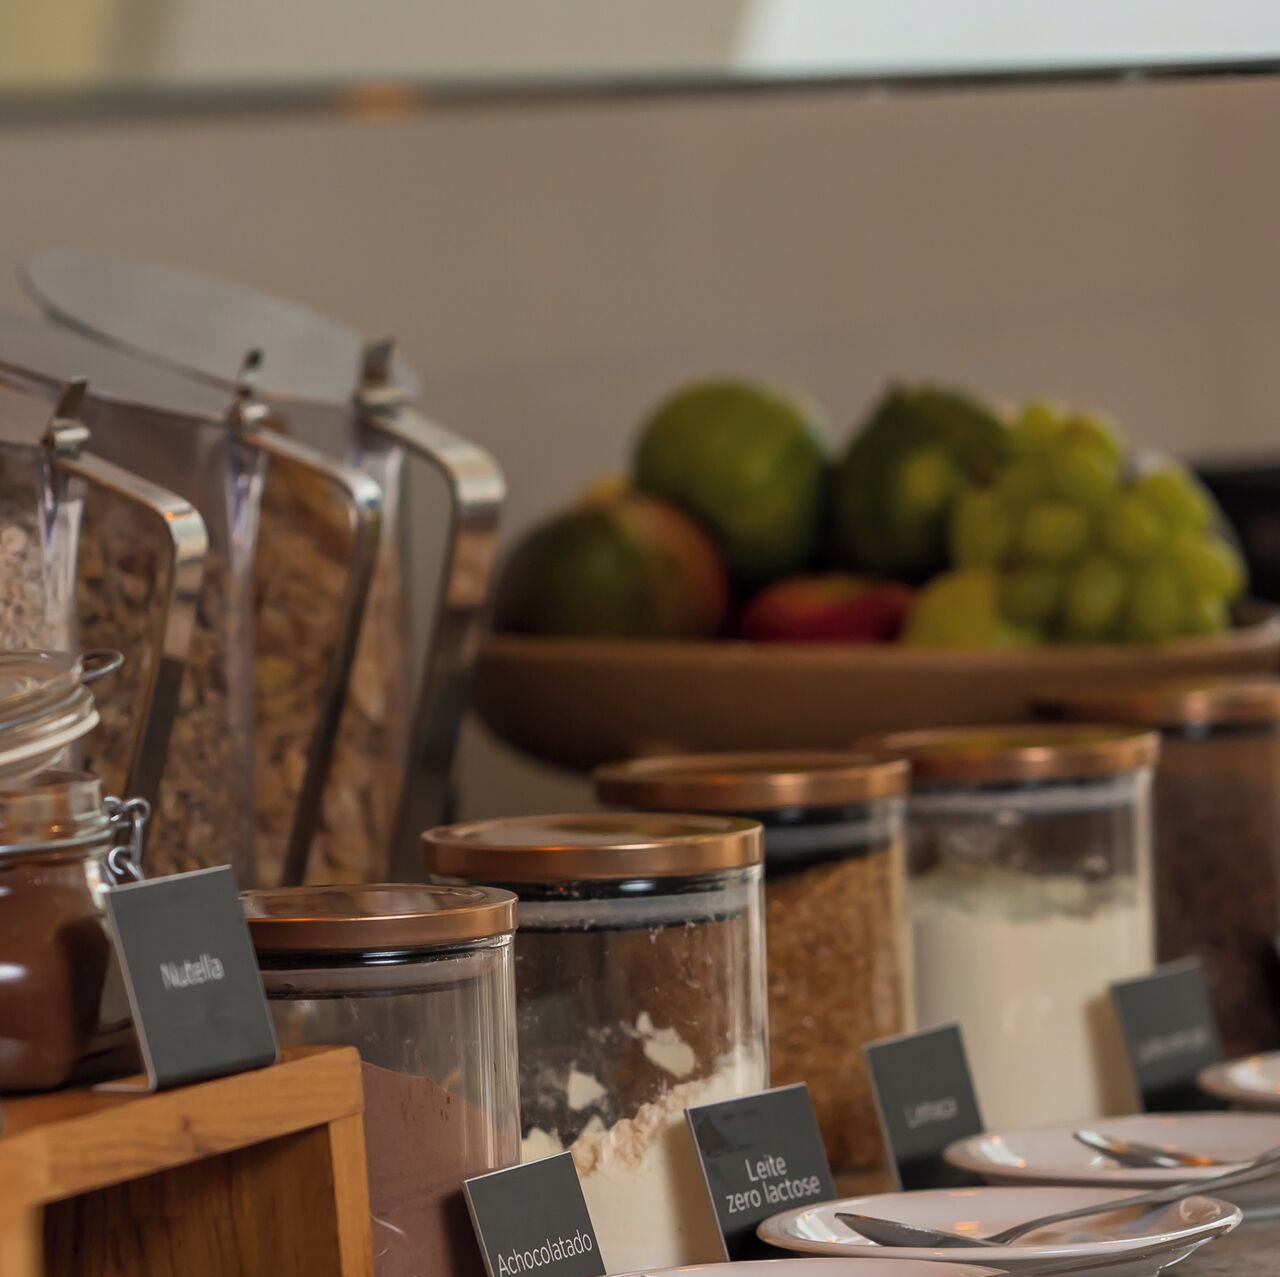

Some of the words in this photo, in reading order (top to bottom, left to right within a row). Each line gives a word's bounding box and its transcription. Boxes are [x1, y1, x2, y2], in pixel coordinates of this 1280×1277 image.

[159, 953, 226, 990] Nutella
[744, 1154, 788, 1182] Leite
[725, 1188, 762, 1214] zero
[762, 1175, 821, 1204] lactose
